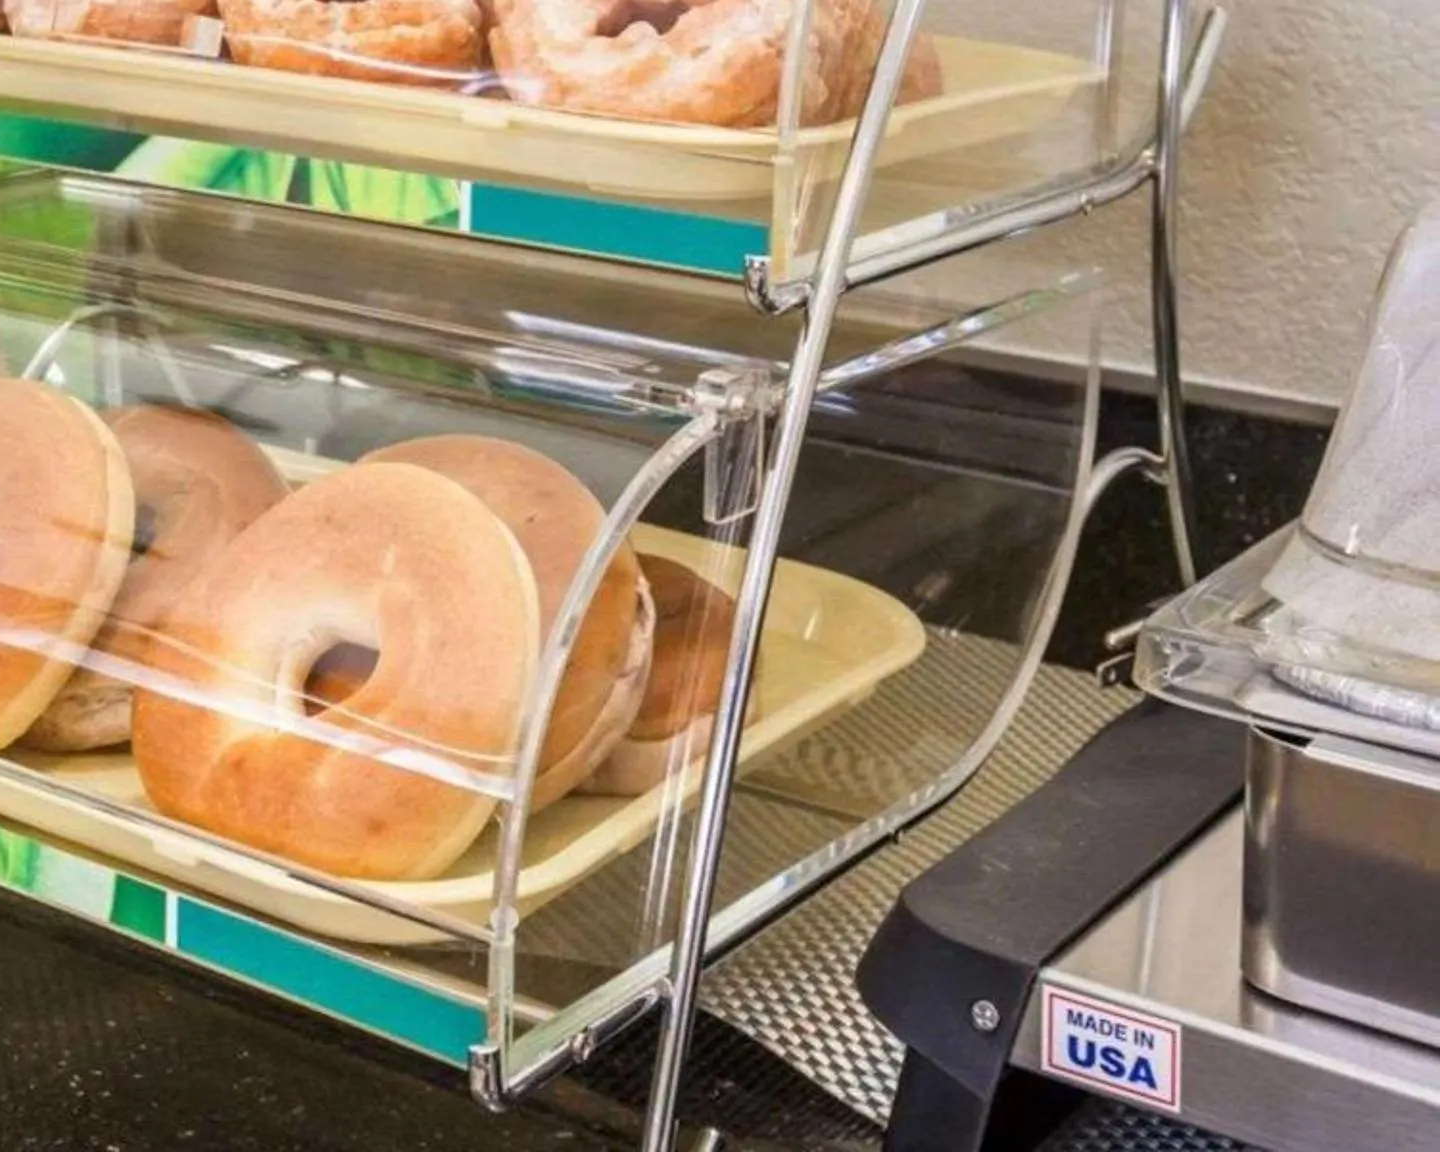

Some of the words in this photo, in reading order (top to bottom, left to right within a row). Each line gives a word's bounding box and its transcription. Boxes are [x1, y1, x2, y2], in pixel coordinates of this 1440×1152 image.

[1066, 1009, 1128, 1042] MADE
[1133, 1029, 1155, 1050] IN
[1067, 1035, 1157, 1089] USA
